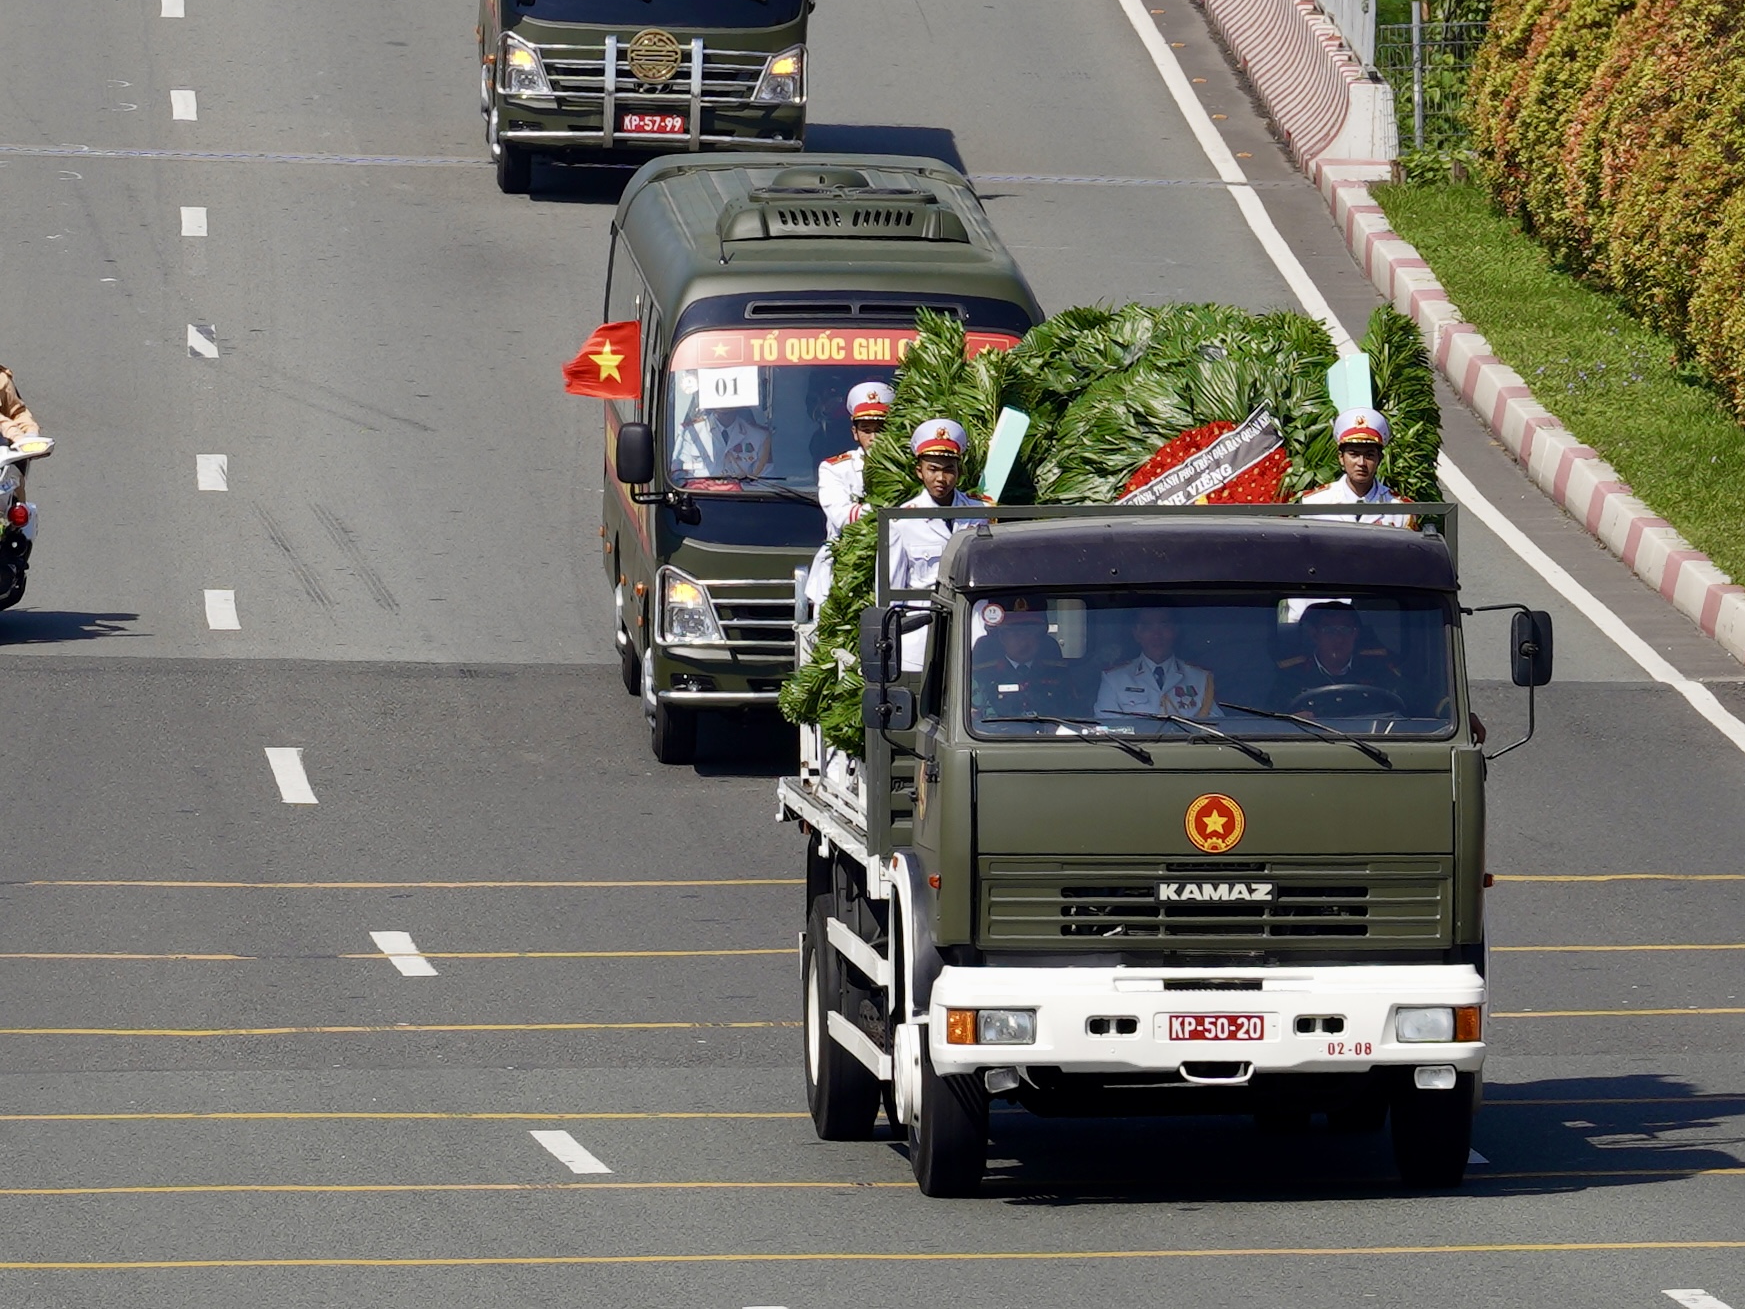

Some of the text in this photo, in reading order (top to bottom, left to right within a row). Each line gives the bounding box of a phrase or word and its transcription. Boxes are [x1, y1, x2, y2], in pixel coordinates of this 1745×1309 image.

[623, 114, 682, 132] KP-57-99
[750, 329, 780, 362] TỔ
[785, 330, 846, 363] QUỐC
[853, 337, 891, 361] GHI
[715, 376, 739, 397] 01
[1186, 463, 1233, 496] VIẾNG
[1159, 883, 1273, 901] KAMAZ
[1171, 1016, 1263, 1039] KP-50-20
[1327, 1042, 1373, 1056] 02-08
